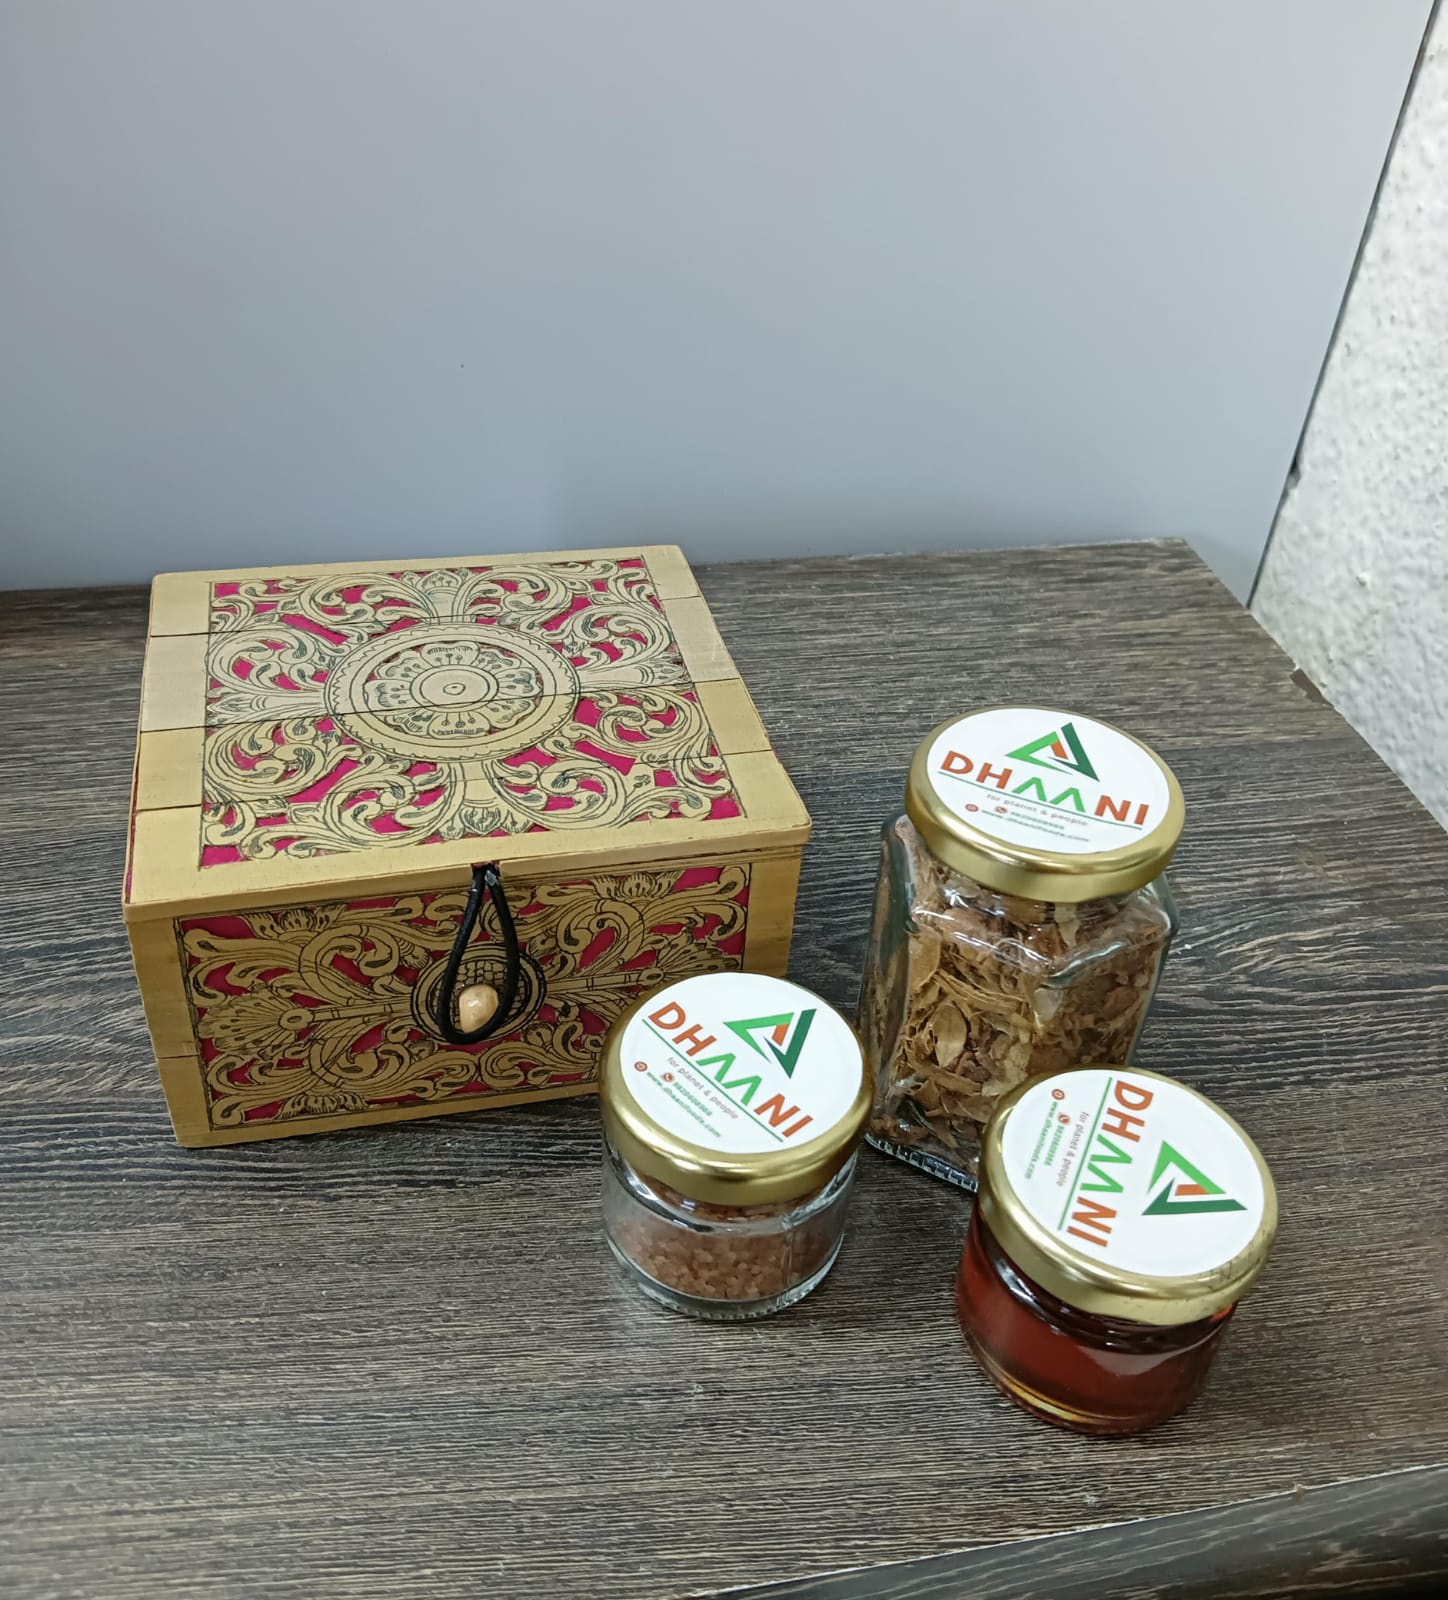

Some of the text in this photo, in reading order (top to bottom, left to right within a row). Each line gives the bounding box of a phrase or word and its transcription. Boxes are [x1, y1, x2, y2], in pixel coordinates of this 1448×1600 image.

[940, 750, 1149, 826] DHAANI
[986, 792, 1004, 803] for
[1002, 796, 1039, 815] planet
[1050, 811, 1089, 827] people
[648, 1001, 813, 1137] DHAANI
[667, 1057, 680, 1068] for
[678, 1067, 705, 1090] planet
[709, 1096, 738, 1119] people
[1069, 1124, 1084, 1150] planet
[1079, 1111, 1089, 1123] for
[1056, 1158, 1071, 1187] people
[1066, 1079, 1154, 1248] DHAANI
